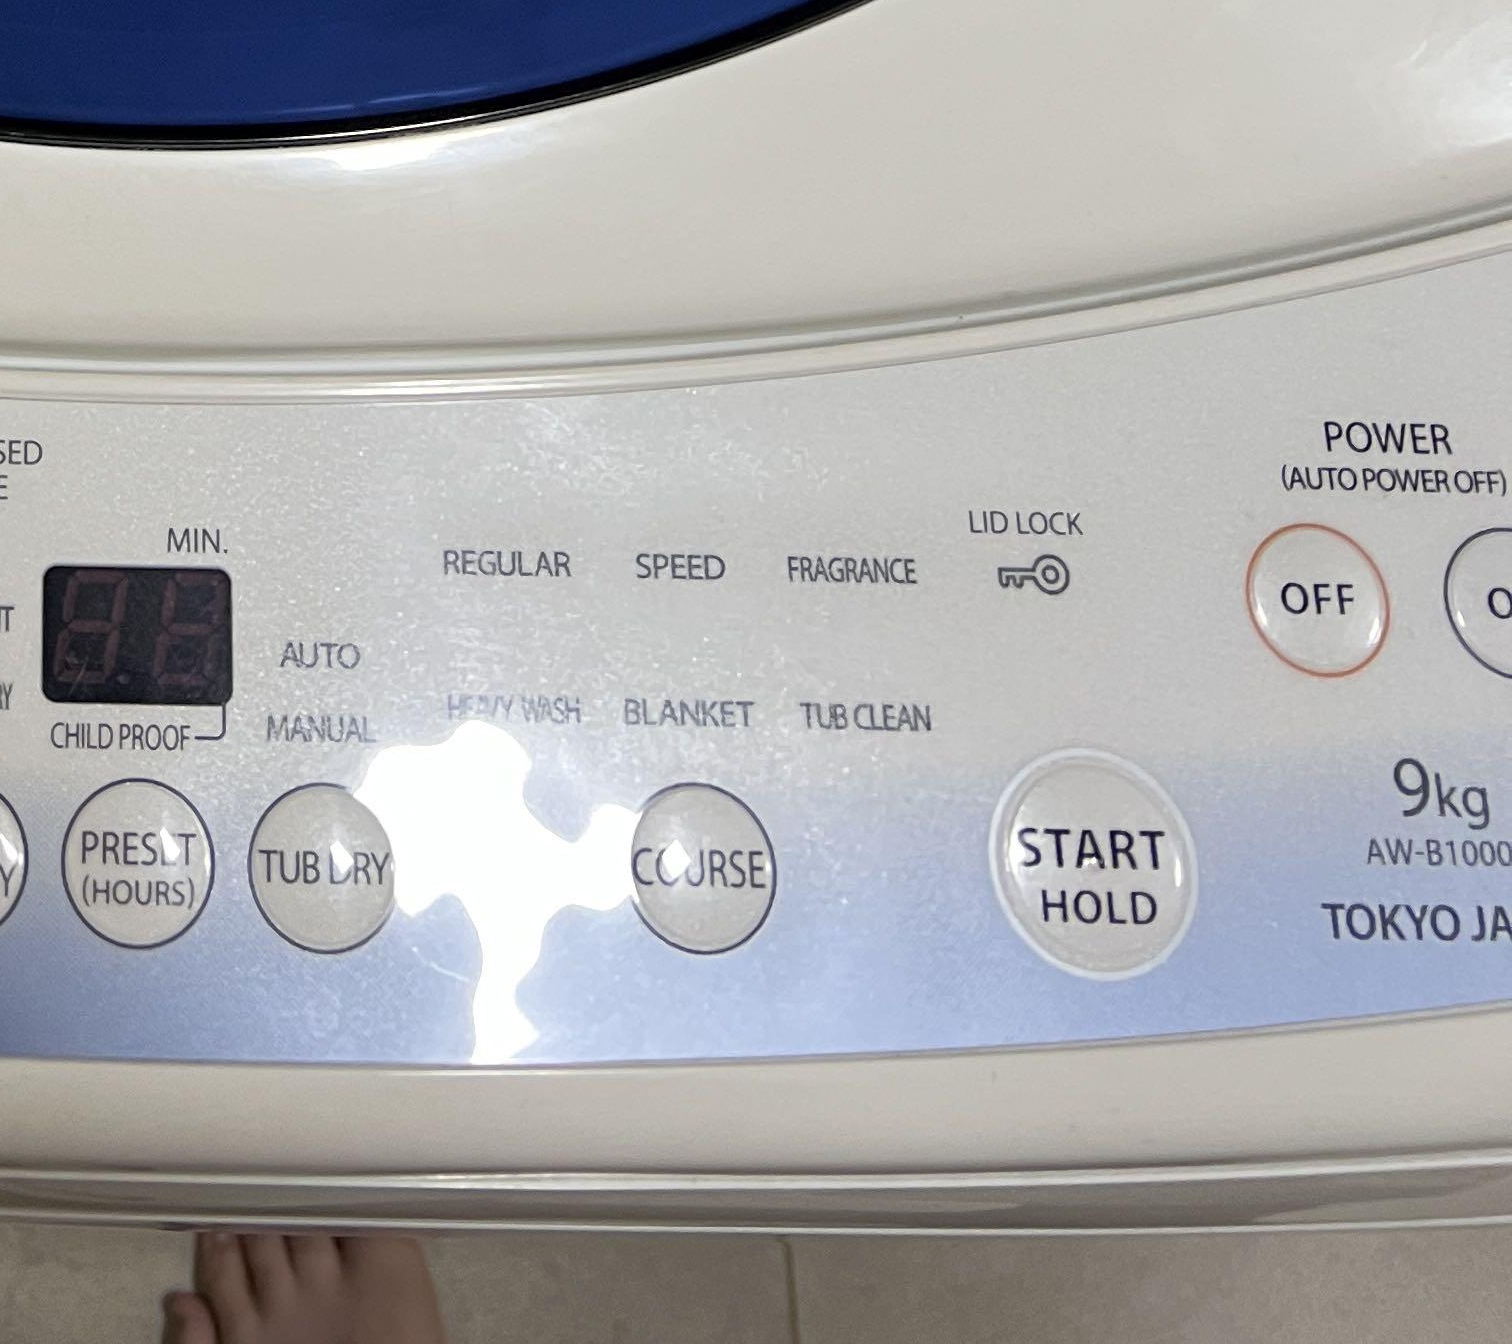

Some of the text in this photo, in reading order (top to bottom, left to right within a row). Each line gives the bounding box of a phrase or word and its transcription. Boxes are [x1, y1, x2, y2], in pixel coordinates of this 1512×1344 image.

[1323, 420, 1453, 455] POWER
[1281, 464, 1507, 497] (AUTO POWER OFF)
[968, 510, 1084, 536] LID LOCK
[167, 527, 228, 554] MIN.
[443, 549, 572, 578] REGULAR
[635, 552, 726, 581] SPEED
[787, 555, 918, 585] FRAGRANCE
[1280, 582, 1354, 615] OFF
[279, 640, 361, 670] AUTO
[521, 695, 582, 724] WASH
[624, 697, 756, 728] BLANKET
[799, 701, 932, 732] TUB CLEAN
[50, 721, 191, 752] CHILD PROOF
[266, 715, 377, 744] MANUAL
[1393, 757, 1490, 831] 9kg
[1018, 827, 1166, 870] START
[1367, 836, 1512, 867] AW-B1000
[258, 847, 390, 885] TUB DRY
[632, 847, 767, 889] COURSE
[81, 875, 195, 909] (HOURS)
[1041, 889, 1158, 925] HOLD
[1320, 902, 1461, 942] TOKYO
